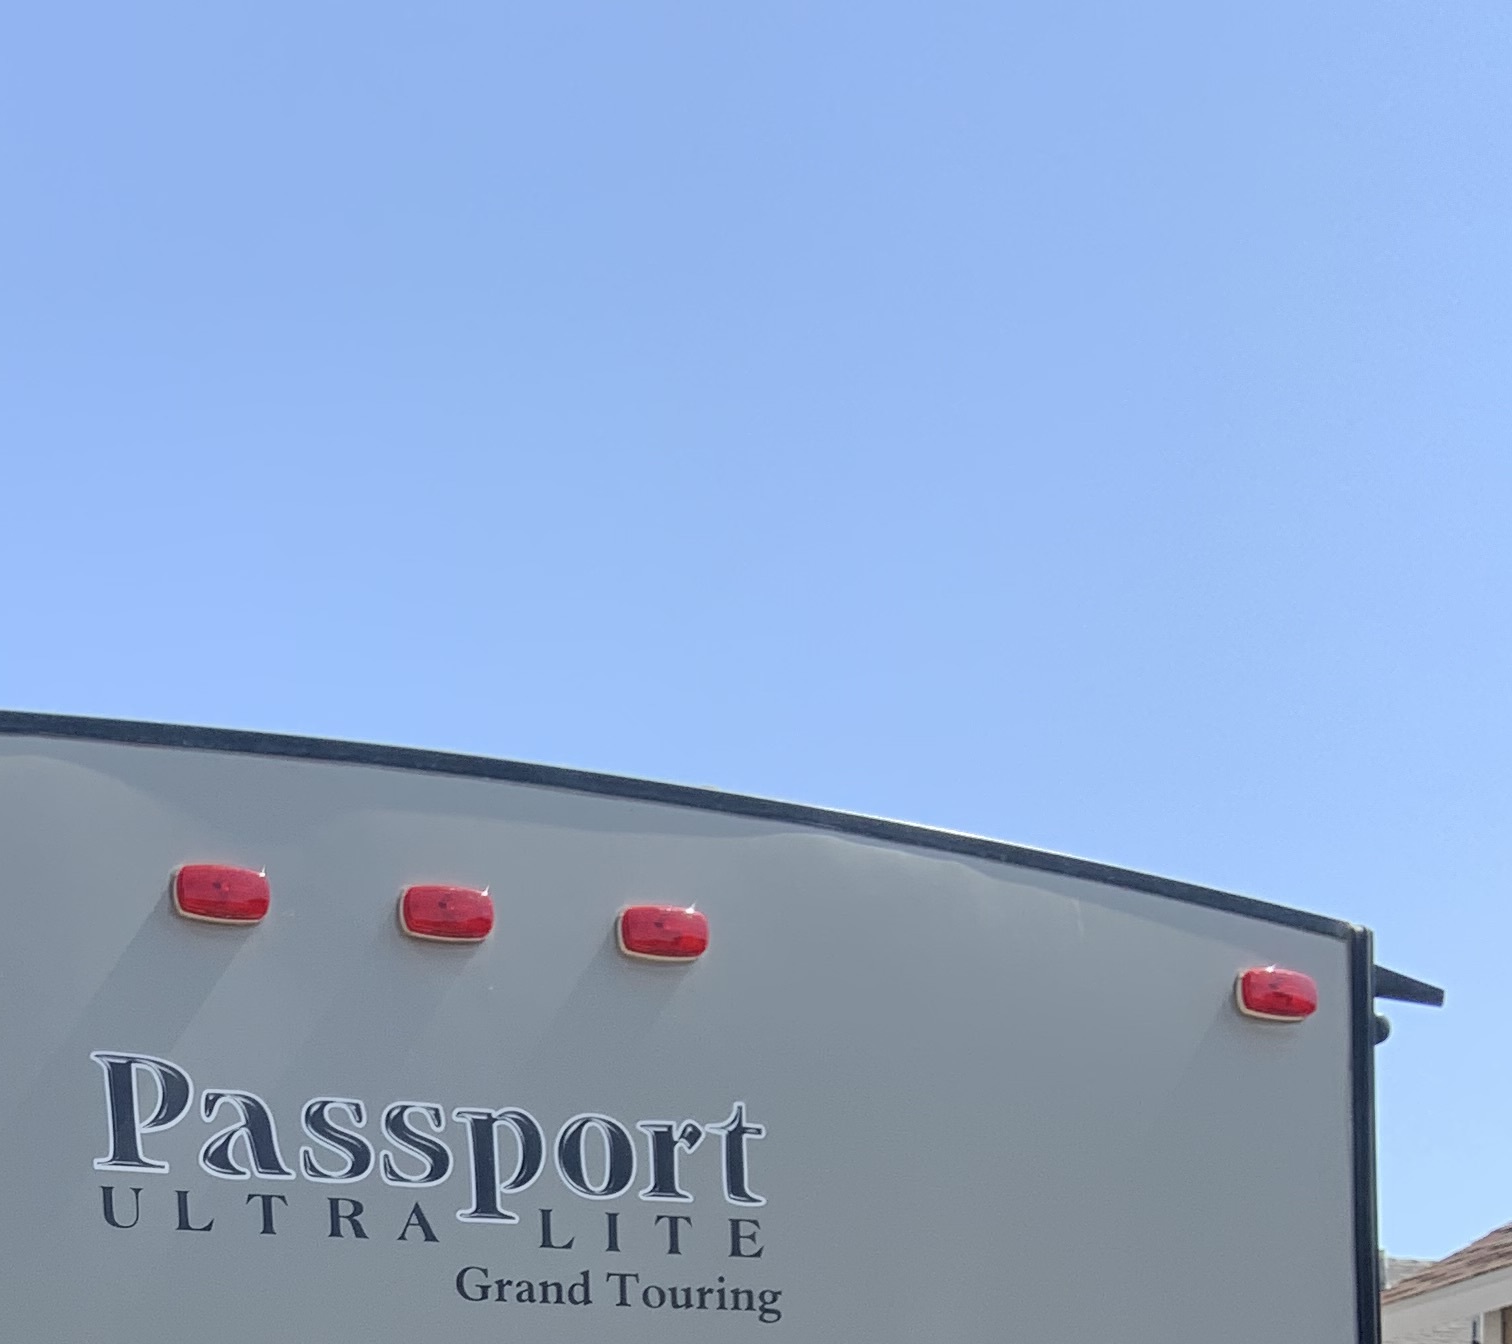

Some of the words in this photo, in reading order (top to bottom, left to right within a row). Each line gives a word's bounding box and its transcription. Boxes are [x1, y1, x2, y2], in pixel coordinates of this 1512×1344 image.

[89, 1051, 767, 1224] Passport
[99, 1185, 441, 1243] ULTRA
[539, 1208, 765, 1259] LITE
[455, 1266, 593, 1307] Grand
[606, 1272, 784, 1323] Touring
